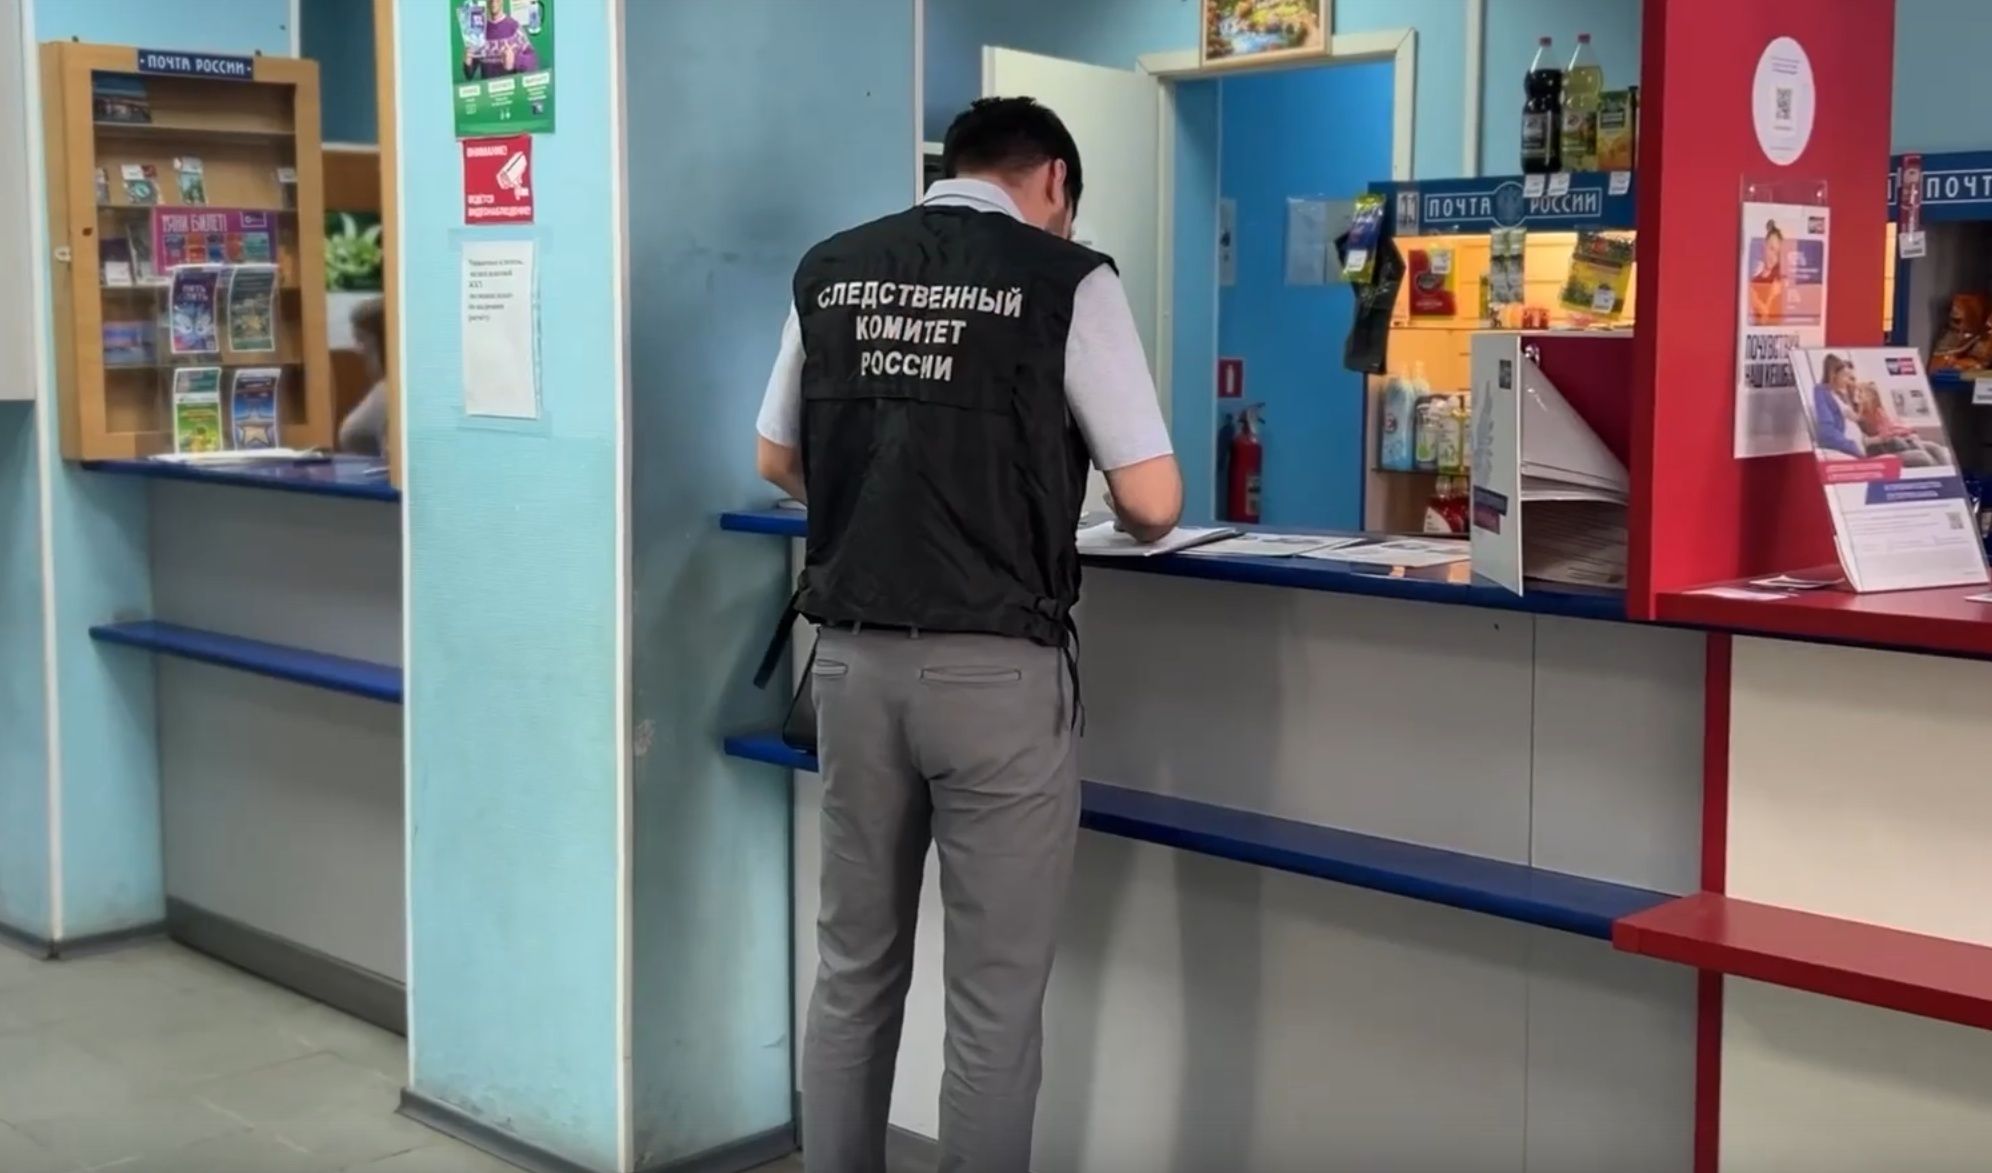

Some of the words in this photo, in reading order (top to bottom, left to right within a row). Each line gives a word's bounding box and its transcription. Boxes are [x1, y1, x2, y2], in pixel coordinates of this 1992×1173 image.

[147, 55, 191, 71] ПОЧТА
[196, 58, 244, 75] РОССИИ
[1429, 197, 1491, 217] ПОЧТА
[1530, 193, 1597, 214] РОССИИ
[818, 281, 1023, 317] СЛЕДСТВЕННЫЙ
[856, 315, 967, 344] КОМИТЕТ
[861, 350, 954, 381] РОССИИ
